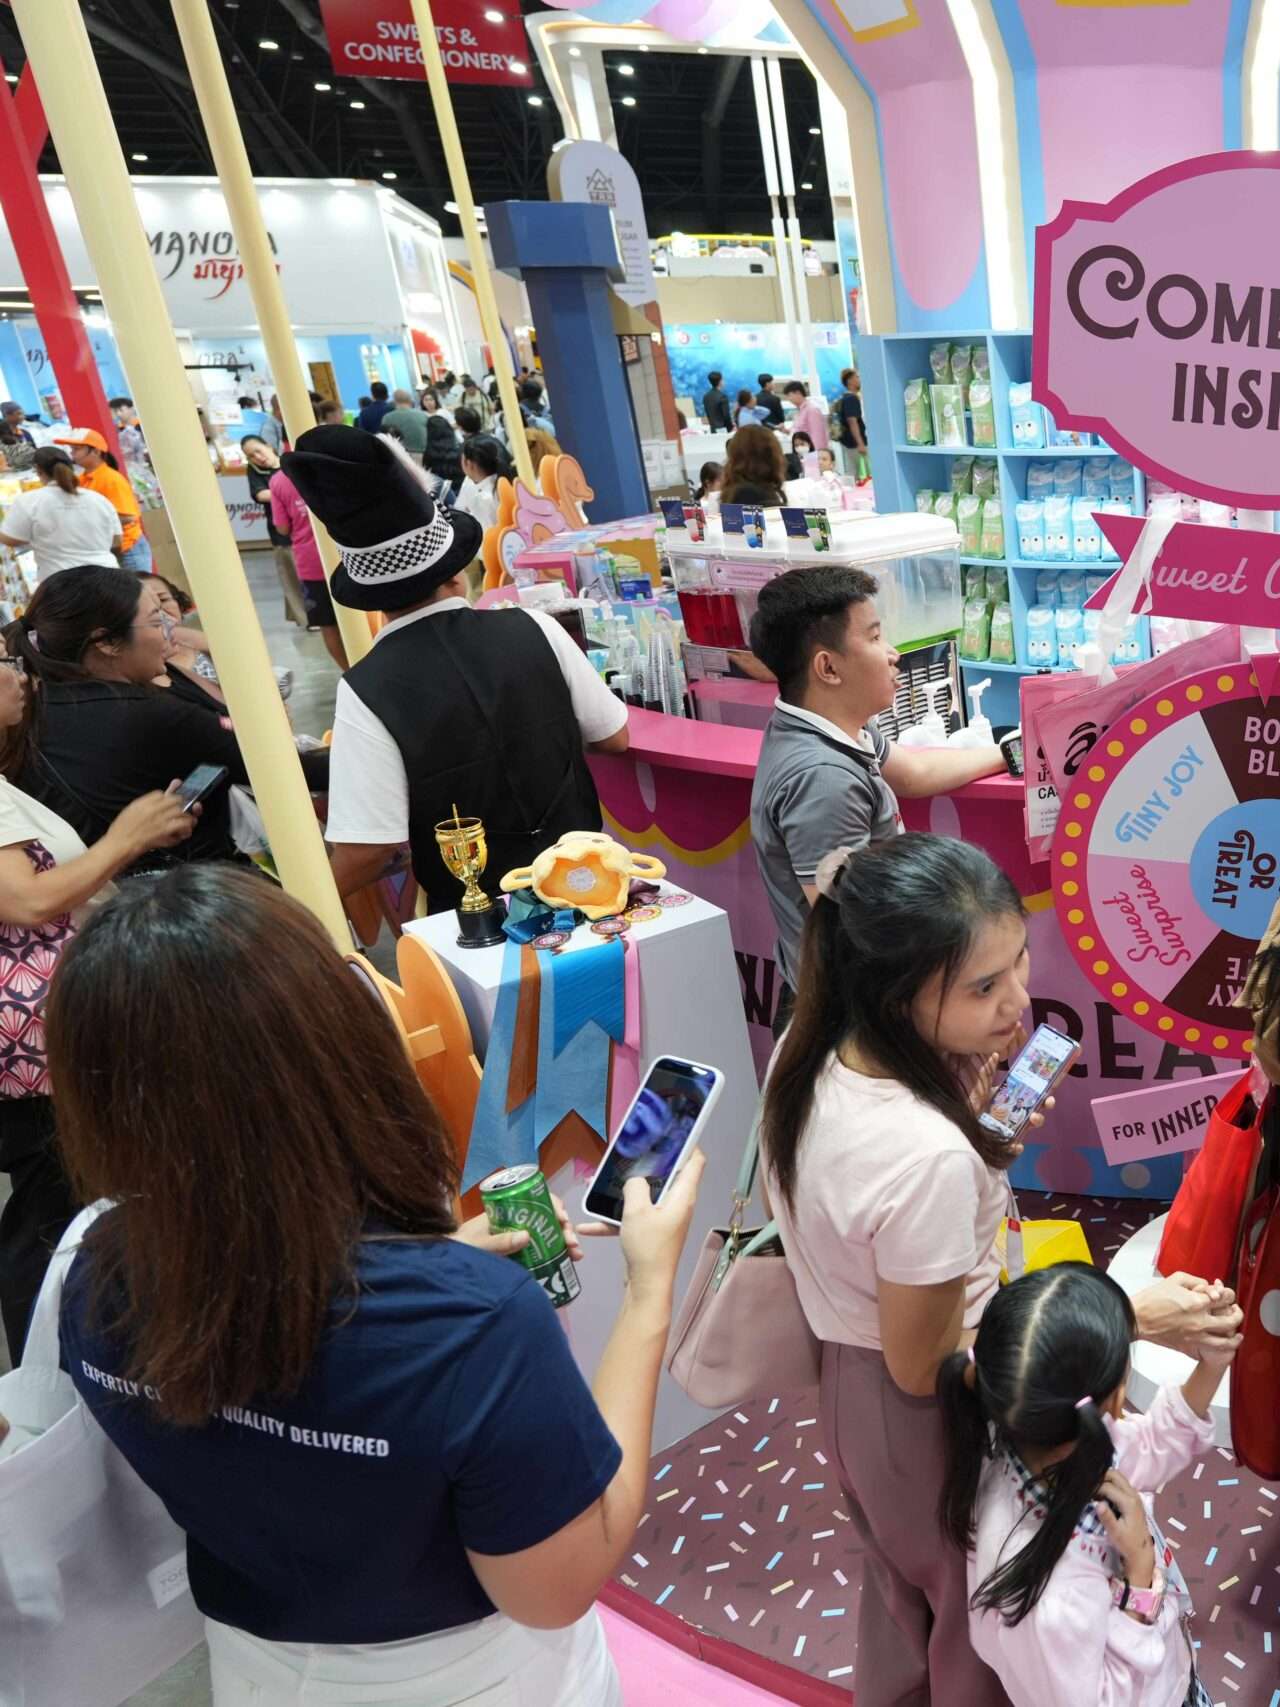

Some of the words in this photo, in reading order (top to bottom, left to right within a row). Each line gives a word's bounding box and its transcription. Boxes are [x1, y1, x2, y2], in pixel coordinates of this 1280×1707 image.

[376, 21, 457, 44] SWETS
[460, 28, 478, 46] &
[344, 42, 515, 71] CONFECIONERY
[1144, 557, 1250, 595] weet
[1114, 790, 1171, 843] TINY
[1163, 745, 1205, 797] JOY
[1211, 829, 1256, 910] TREAT
[1249, 853, 1277, 890] OR
[1102, 890, 1160, 962] Sweet
[1129, 864, 1192, 967] Surprise
[1111, 1121, 1146, 1141] FOR
[484, 1203, 560, 1249] ORIGINAL
[81, 1359, 140, 1398] EXPERTLY
[222, 1405, 285, 1438] QUALITY
[289, 1425, 390, 1457] DELIVERED
